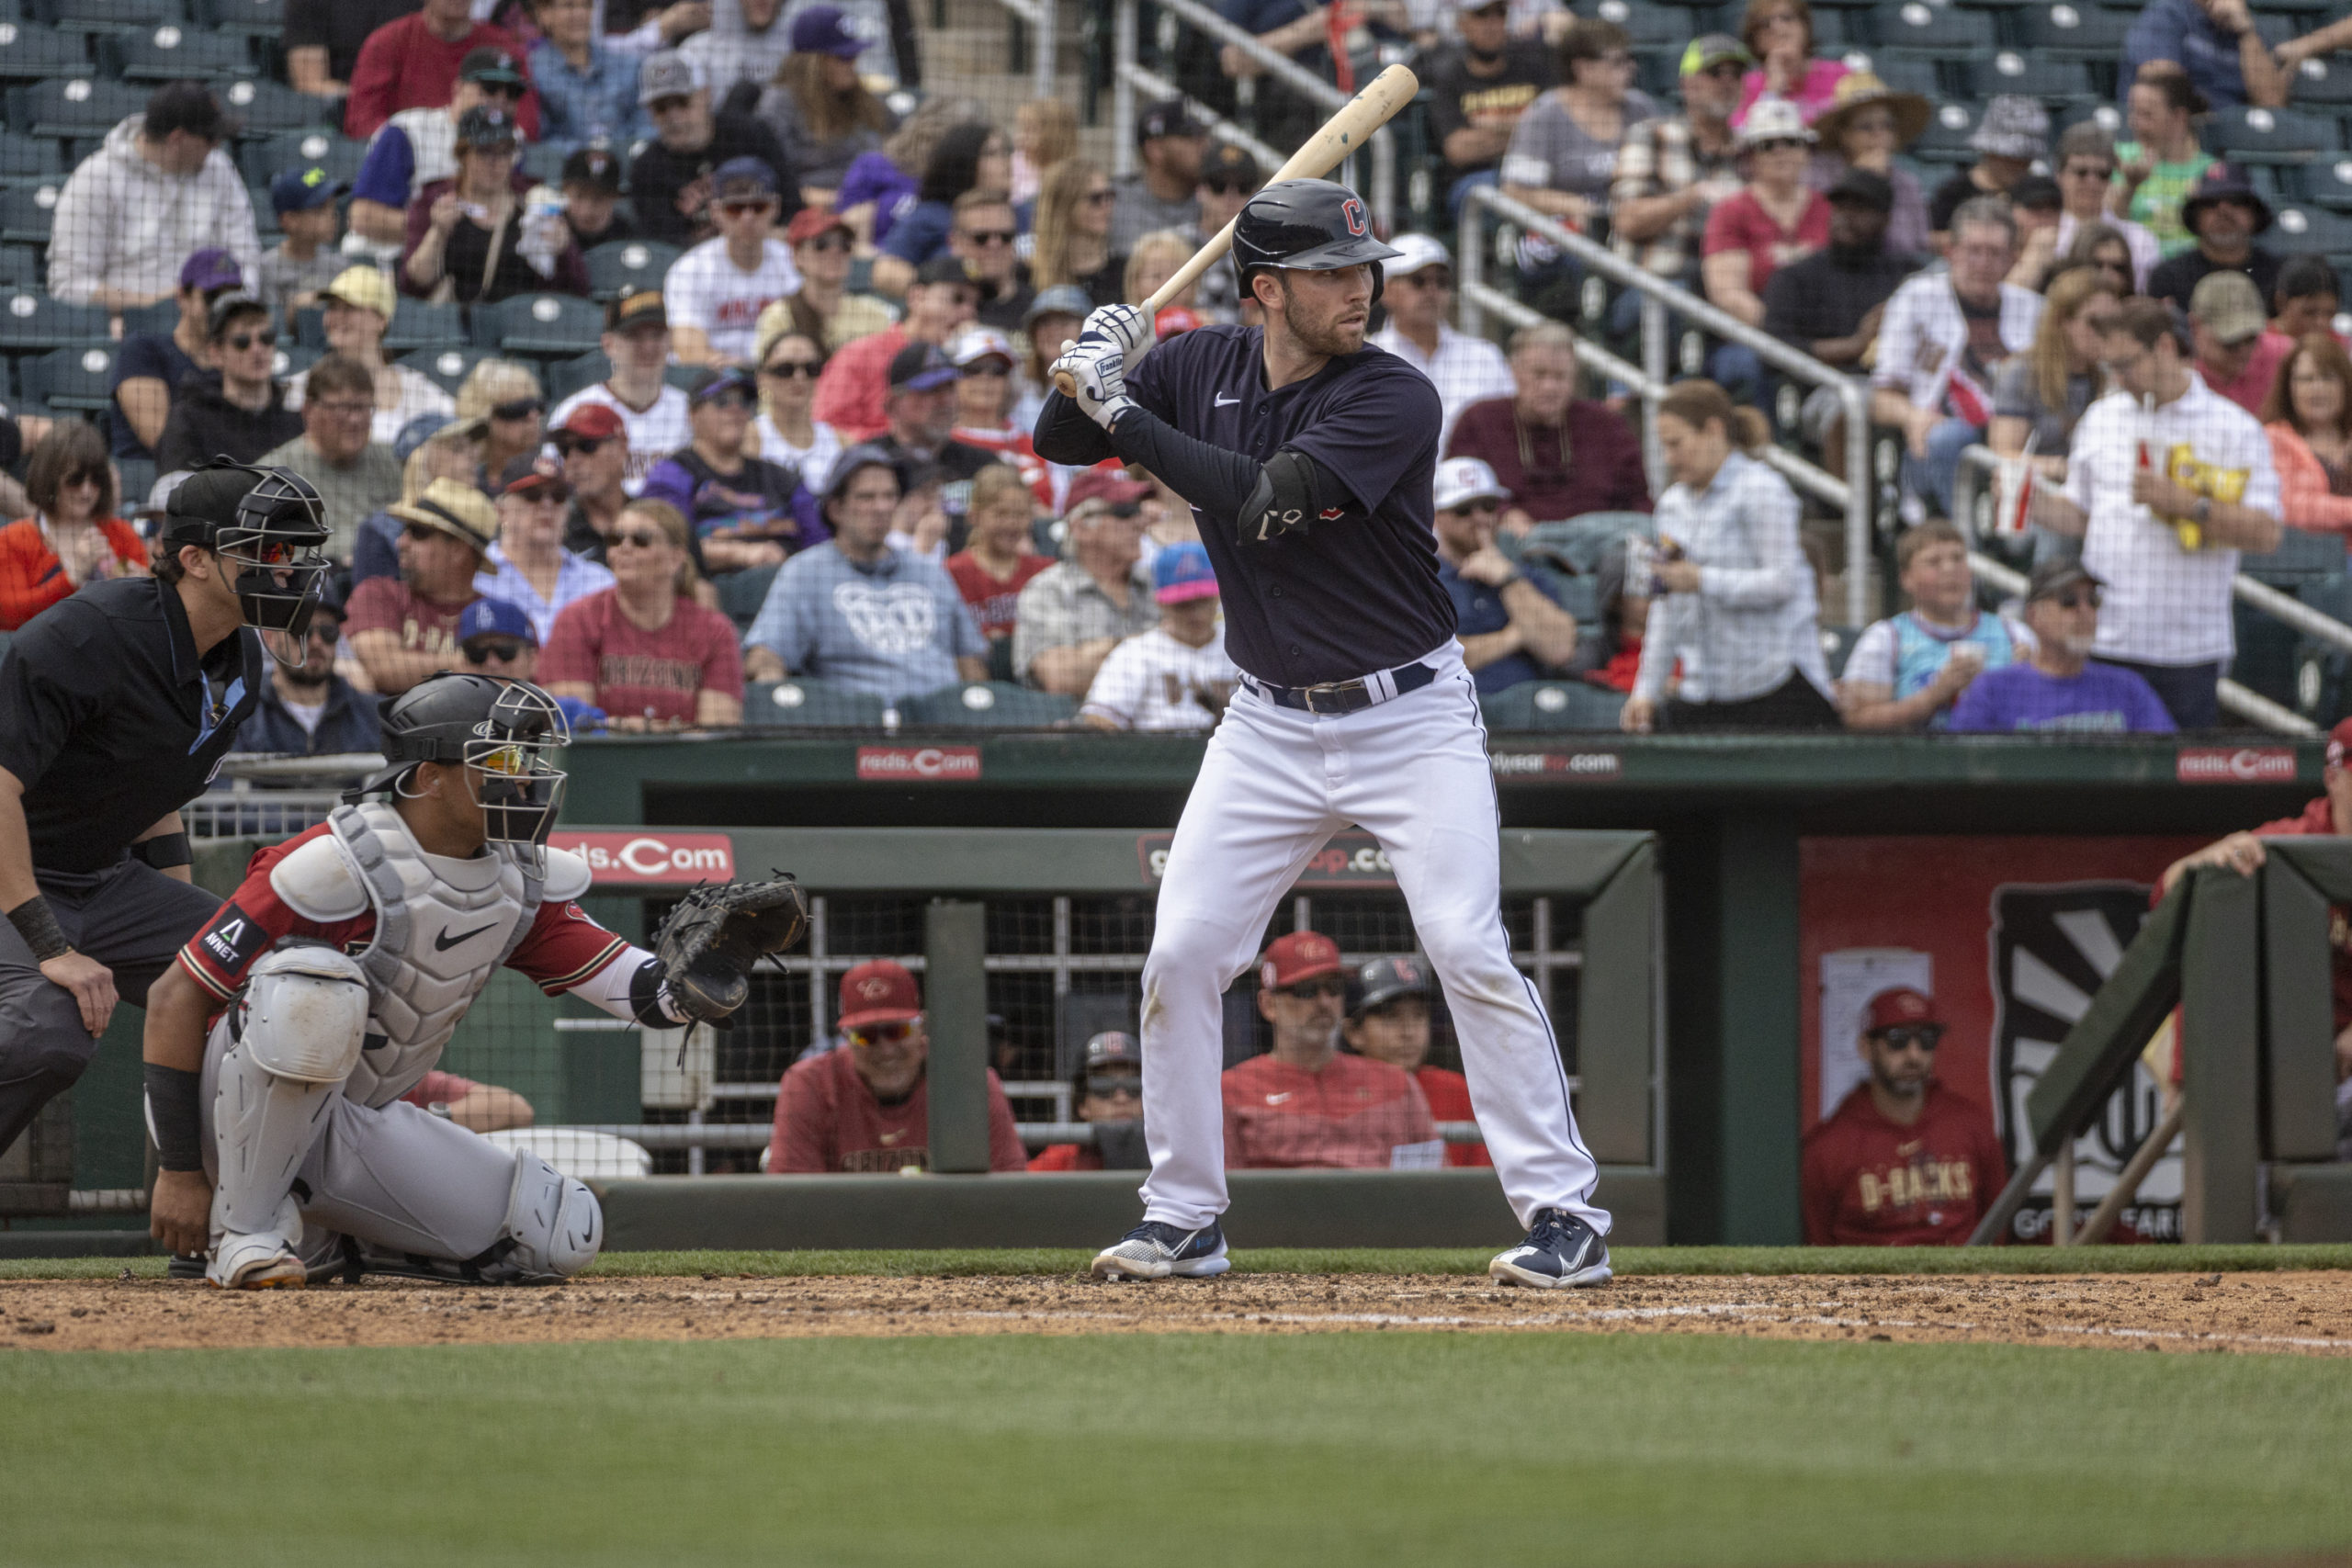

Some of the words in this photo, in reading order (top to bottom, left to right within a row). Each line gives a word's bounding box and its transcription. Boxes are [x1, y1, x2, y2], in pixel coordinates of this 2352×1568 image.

[1341, 198, 1366, 237] C
[1100, 357, 1123, 376] Franklin
[568, 838, 727, 875] ds.Com
[204, 931, 239, 963] AVNET
[1859, 1161, 1973, 1212] D-BACKS
